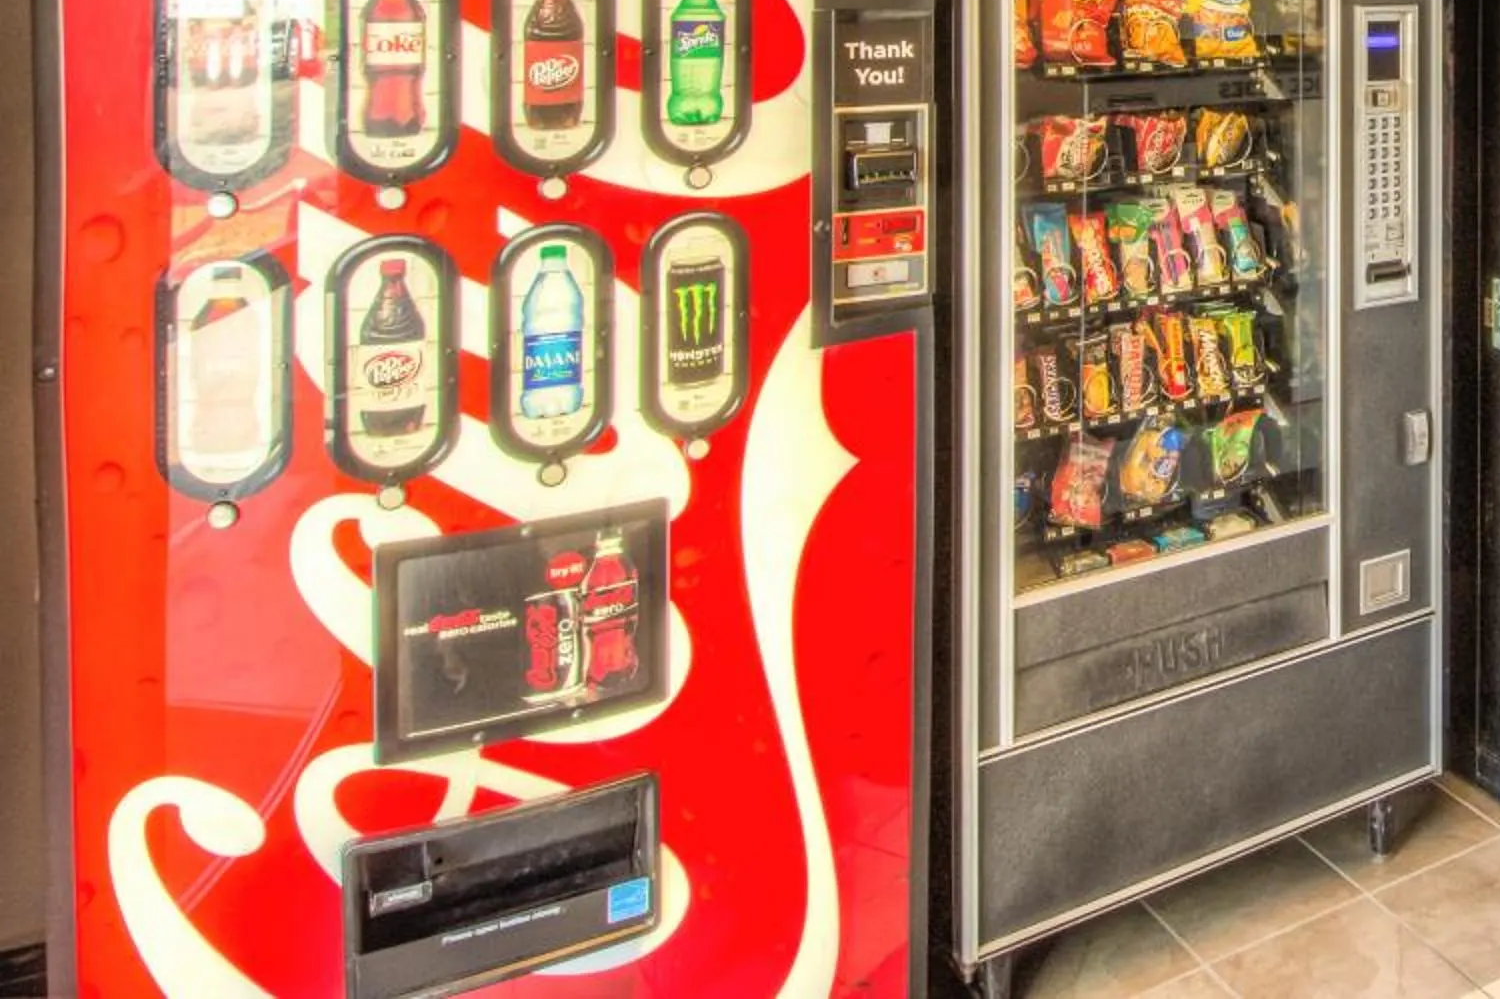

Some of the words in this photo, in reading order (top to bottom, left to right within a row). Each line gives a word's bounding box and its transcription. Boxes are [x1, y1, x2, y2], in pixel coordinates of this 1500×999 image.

[843, 40, 915, 60] Thank
[853, 66, 905, 86] You!
[525, 351, 580, 370] DASANI
[558, 618, 575, 666] zero
